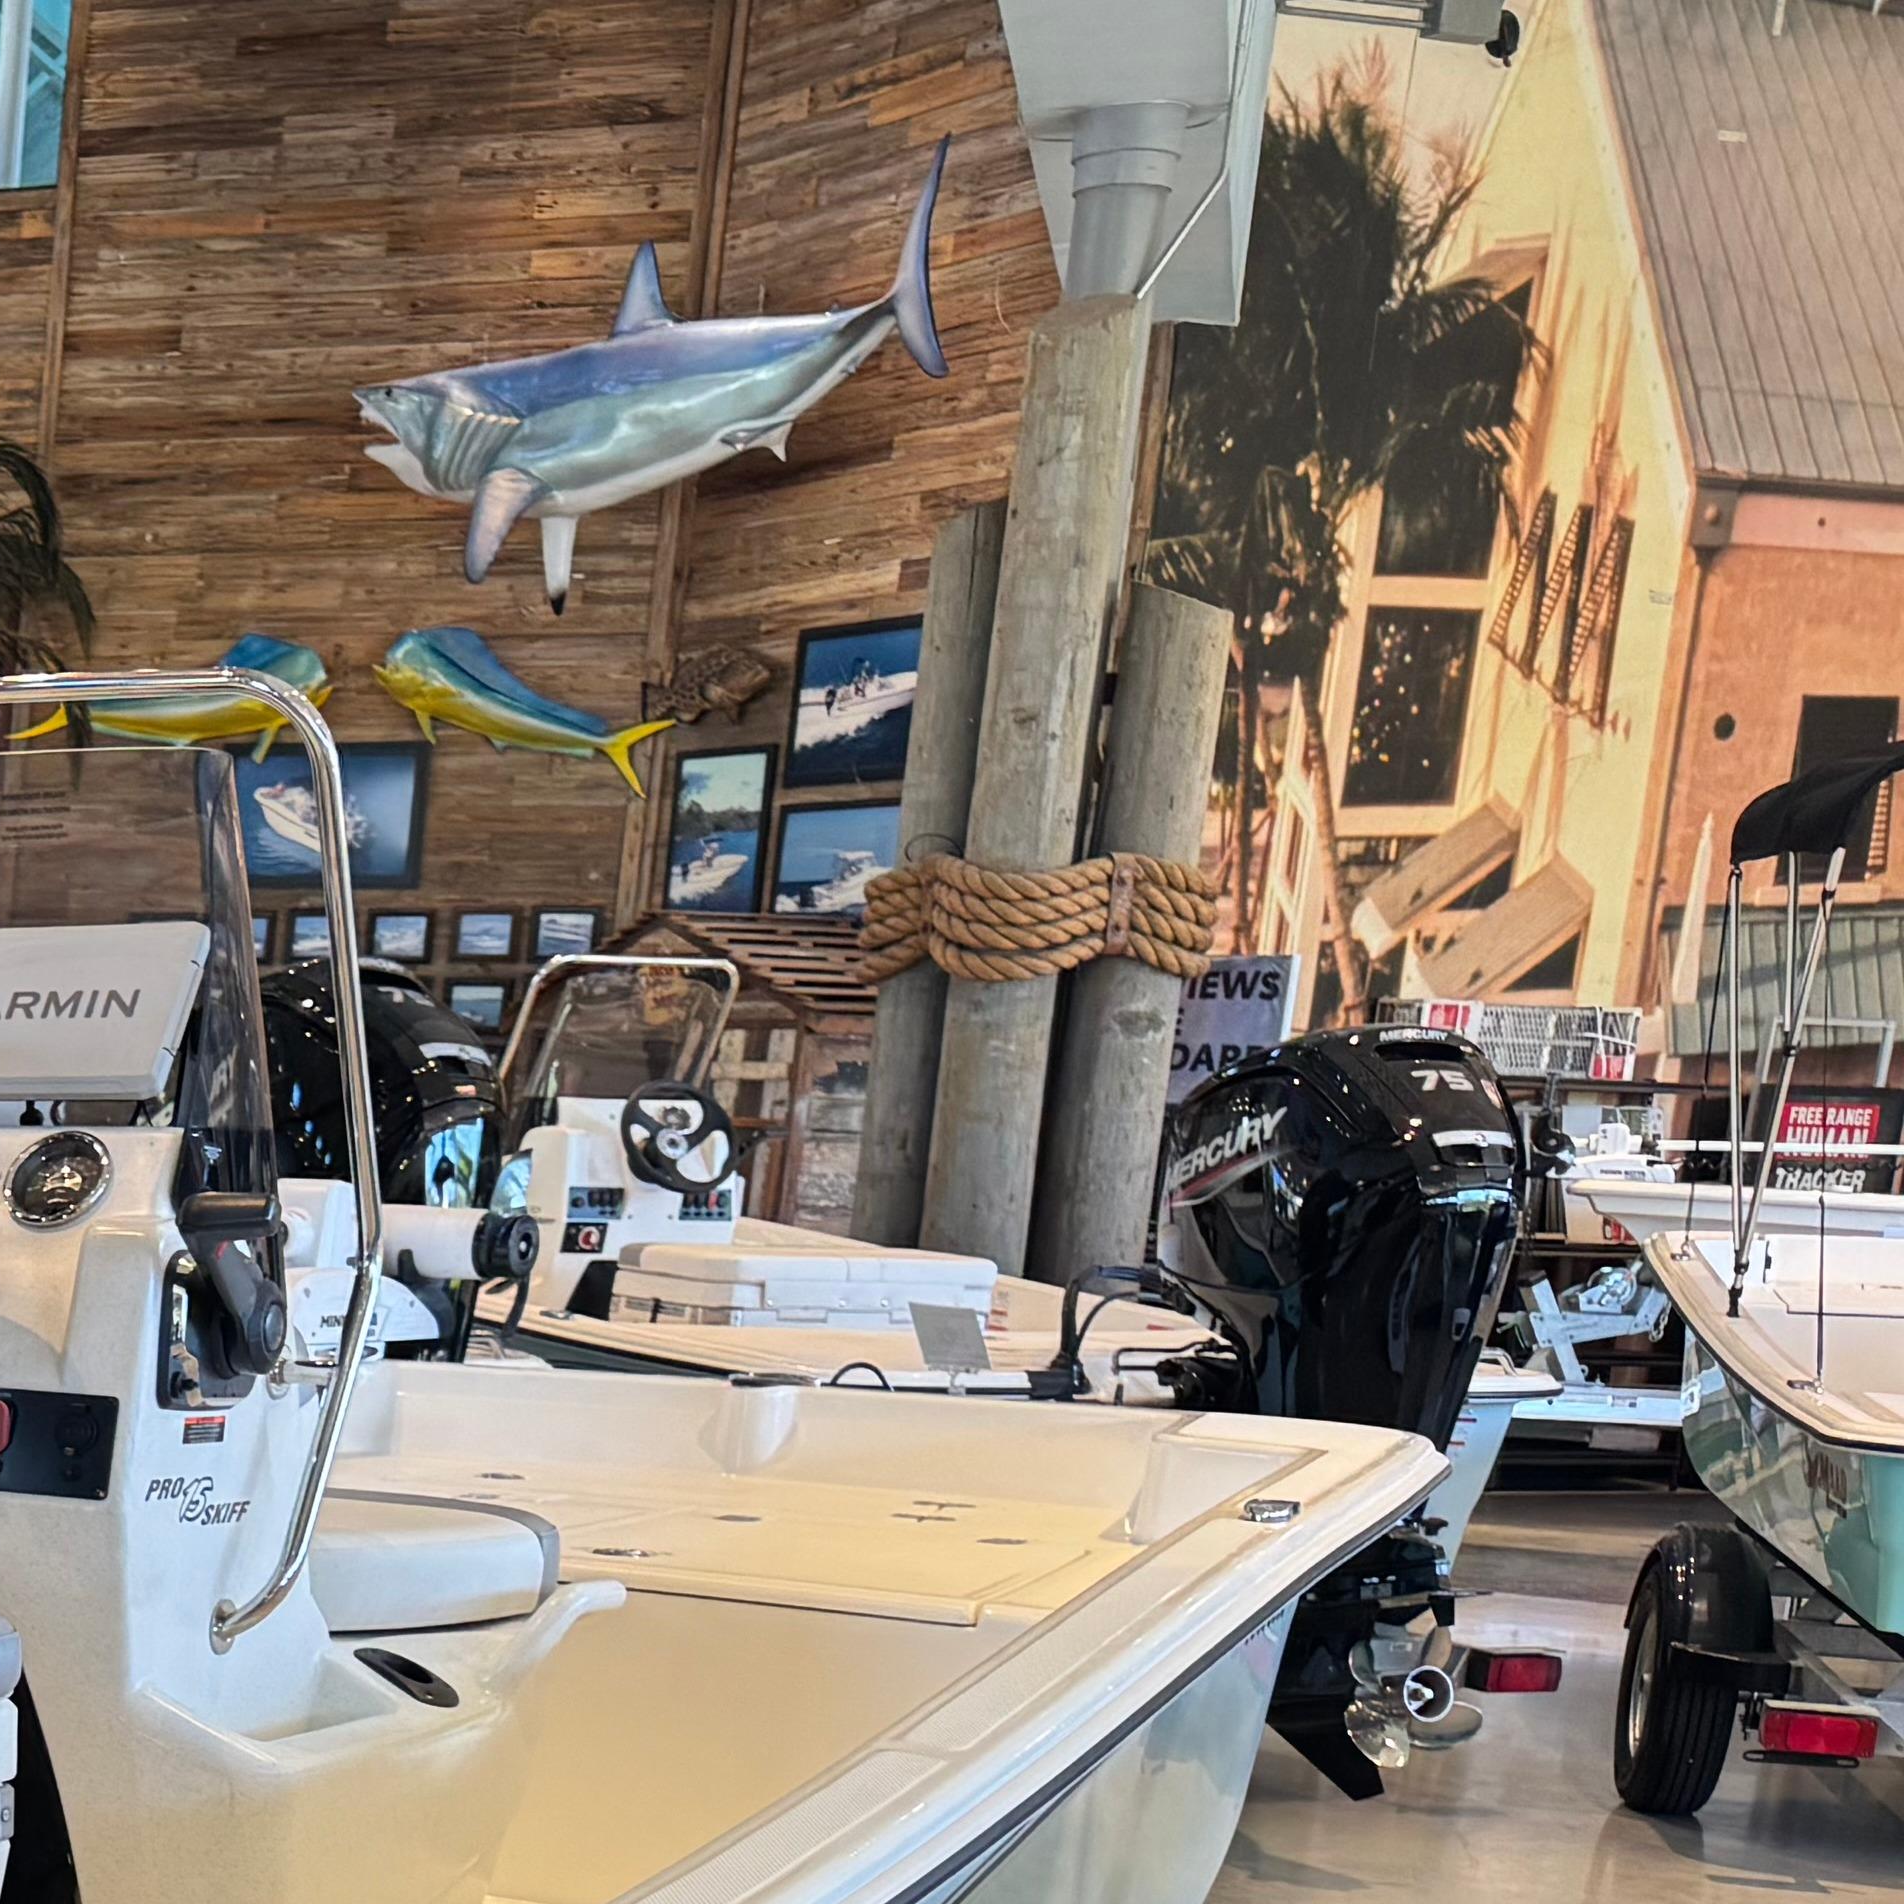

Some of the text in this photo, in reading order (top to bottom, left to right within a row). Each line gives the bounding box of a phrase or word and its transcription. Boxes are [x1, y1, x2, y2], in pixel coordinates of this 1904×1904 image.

[1380, 1028, 1448, 1042] MERCURY
[1410, 1069, 1475, 1091] 75
[1788, 1106, 1873, 1126] FREE RANGE
[1168, 1106, 1288, 1188] MERCURY
[1775, 1167, 1866, 1193] TRACKER
[145, 1476, 185, 1502] PRO
[179, 1476, 214, 1523] 15
[201, 1501, 251, 1526] SKIFF
